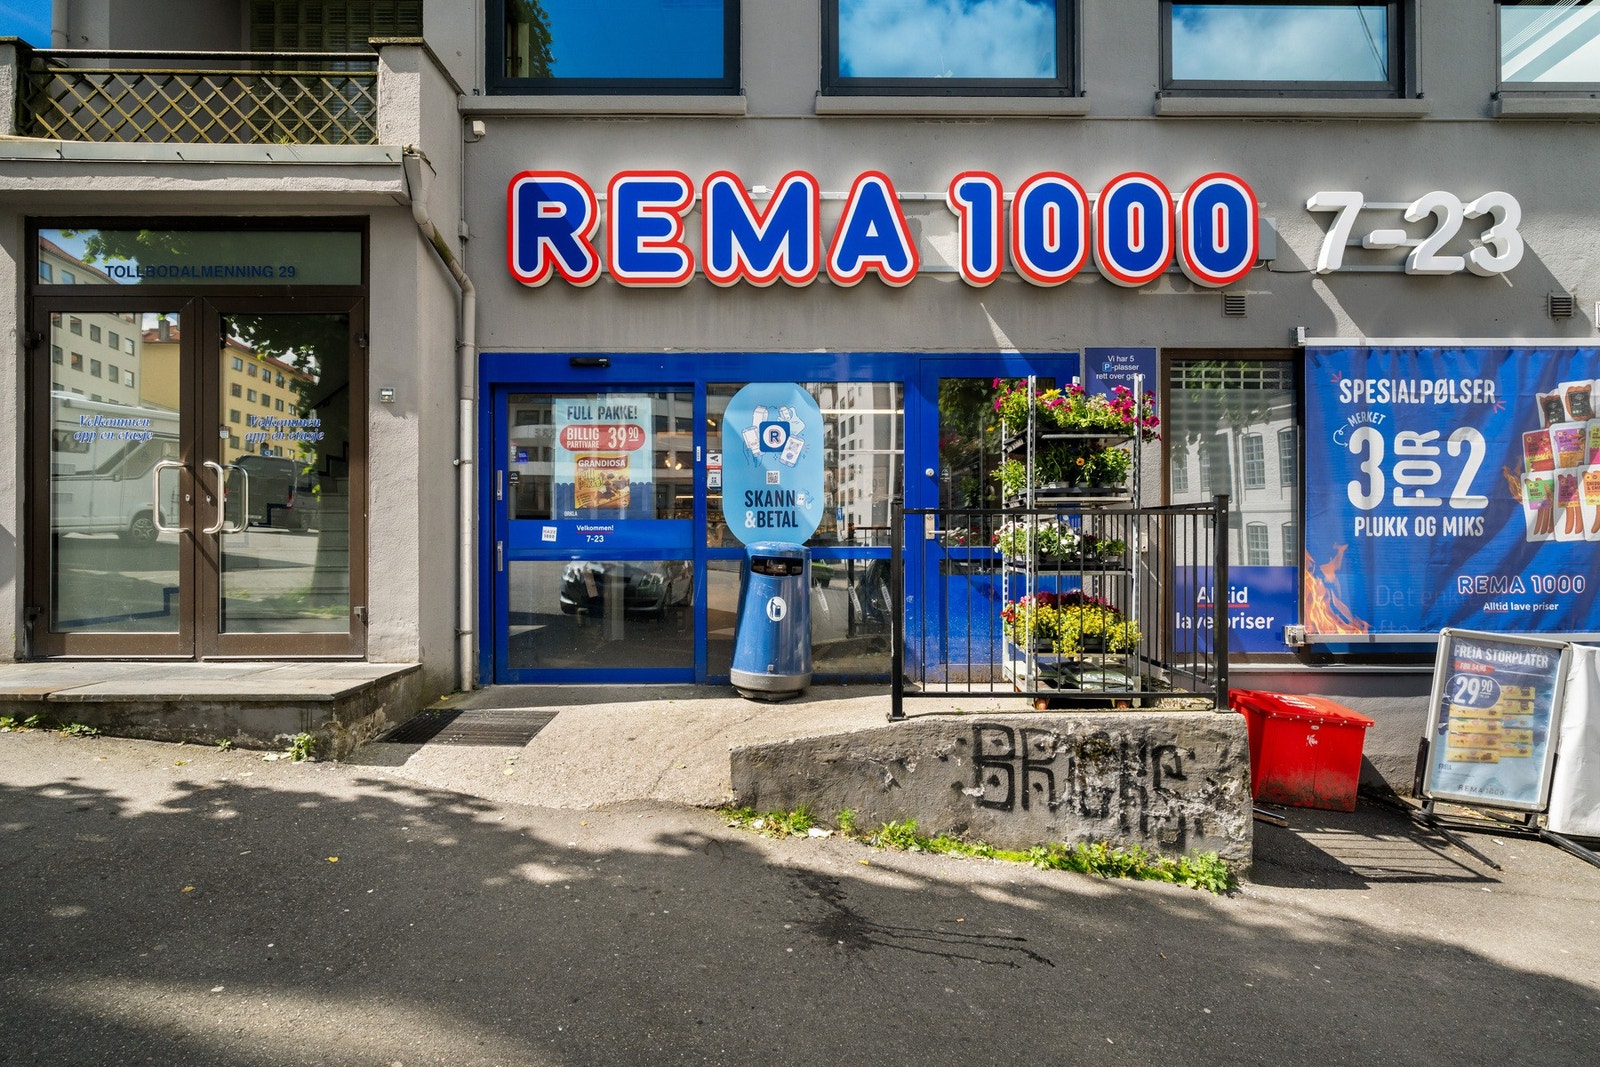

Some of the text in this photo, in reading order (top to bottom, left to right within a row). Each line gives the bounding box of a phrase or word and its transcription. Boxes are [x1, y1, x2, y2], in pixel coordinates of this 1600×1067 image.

[507, 170, 1259, 287] REMA 1000
[1306, 191, 1524, 277] 7-23
[105, 265, 296, 278] TOLLBODALMENNING 29
[1339, 379, 1496, 404] SPESIALPØLSER
[567, 405, 638, 420] FULL PAKKE!
[1347, 411, 1386, 427] MERKET
[79, 415, 151, 427] Velkommen
[250, 415, 321, 427] Velkommen
[73, 428, 153, 443] opp en etasje
[245, 428, 325, 443] opp en etasje
[567, 428, 599, 440] BILLIG
[608, 427, 639, 448] 39 90
[567, 441, 599, 449] PARTIVARE
[578, 459, 626, 467] GRANDIOSA
[1347, 426, 1489, 510] 3 FOR 2
[745, 490, 796, 508] SKANN
[744, 510, 799, 528] &BETAL
[1354, 516, 1485, 537] PLUKK OG MIKS
[1457, 575, 1586, 595] REMA 1000
[1483, 601, 1559, 612] Alltid lave priser
[1228, 612, 1274, 629] riser
[1454, 645, 1549, 669] FREIA STORPLATER
[1453, 677, 1493, 704] 29 90
[1458, 784, 1483, 793] REMA
